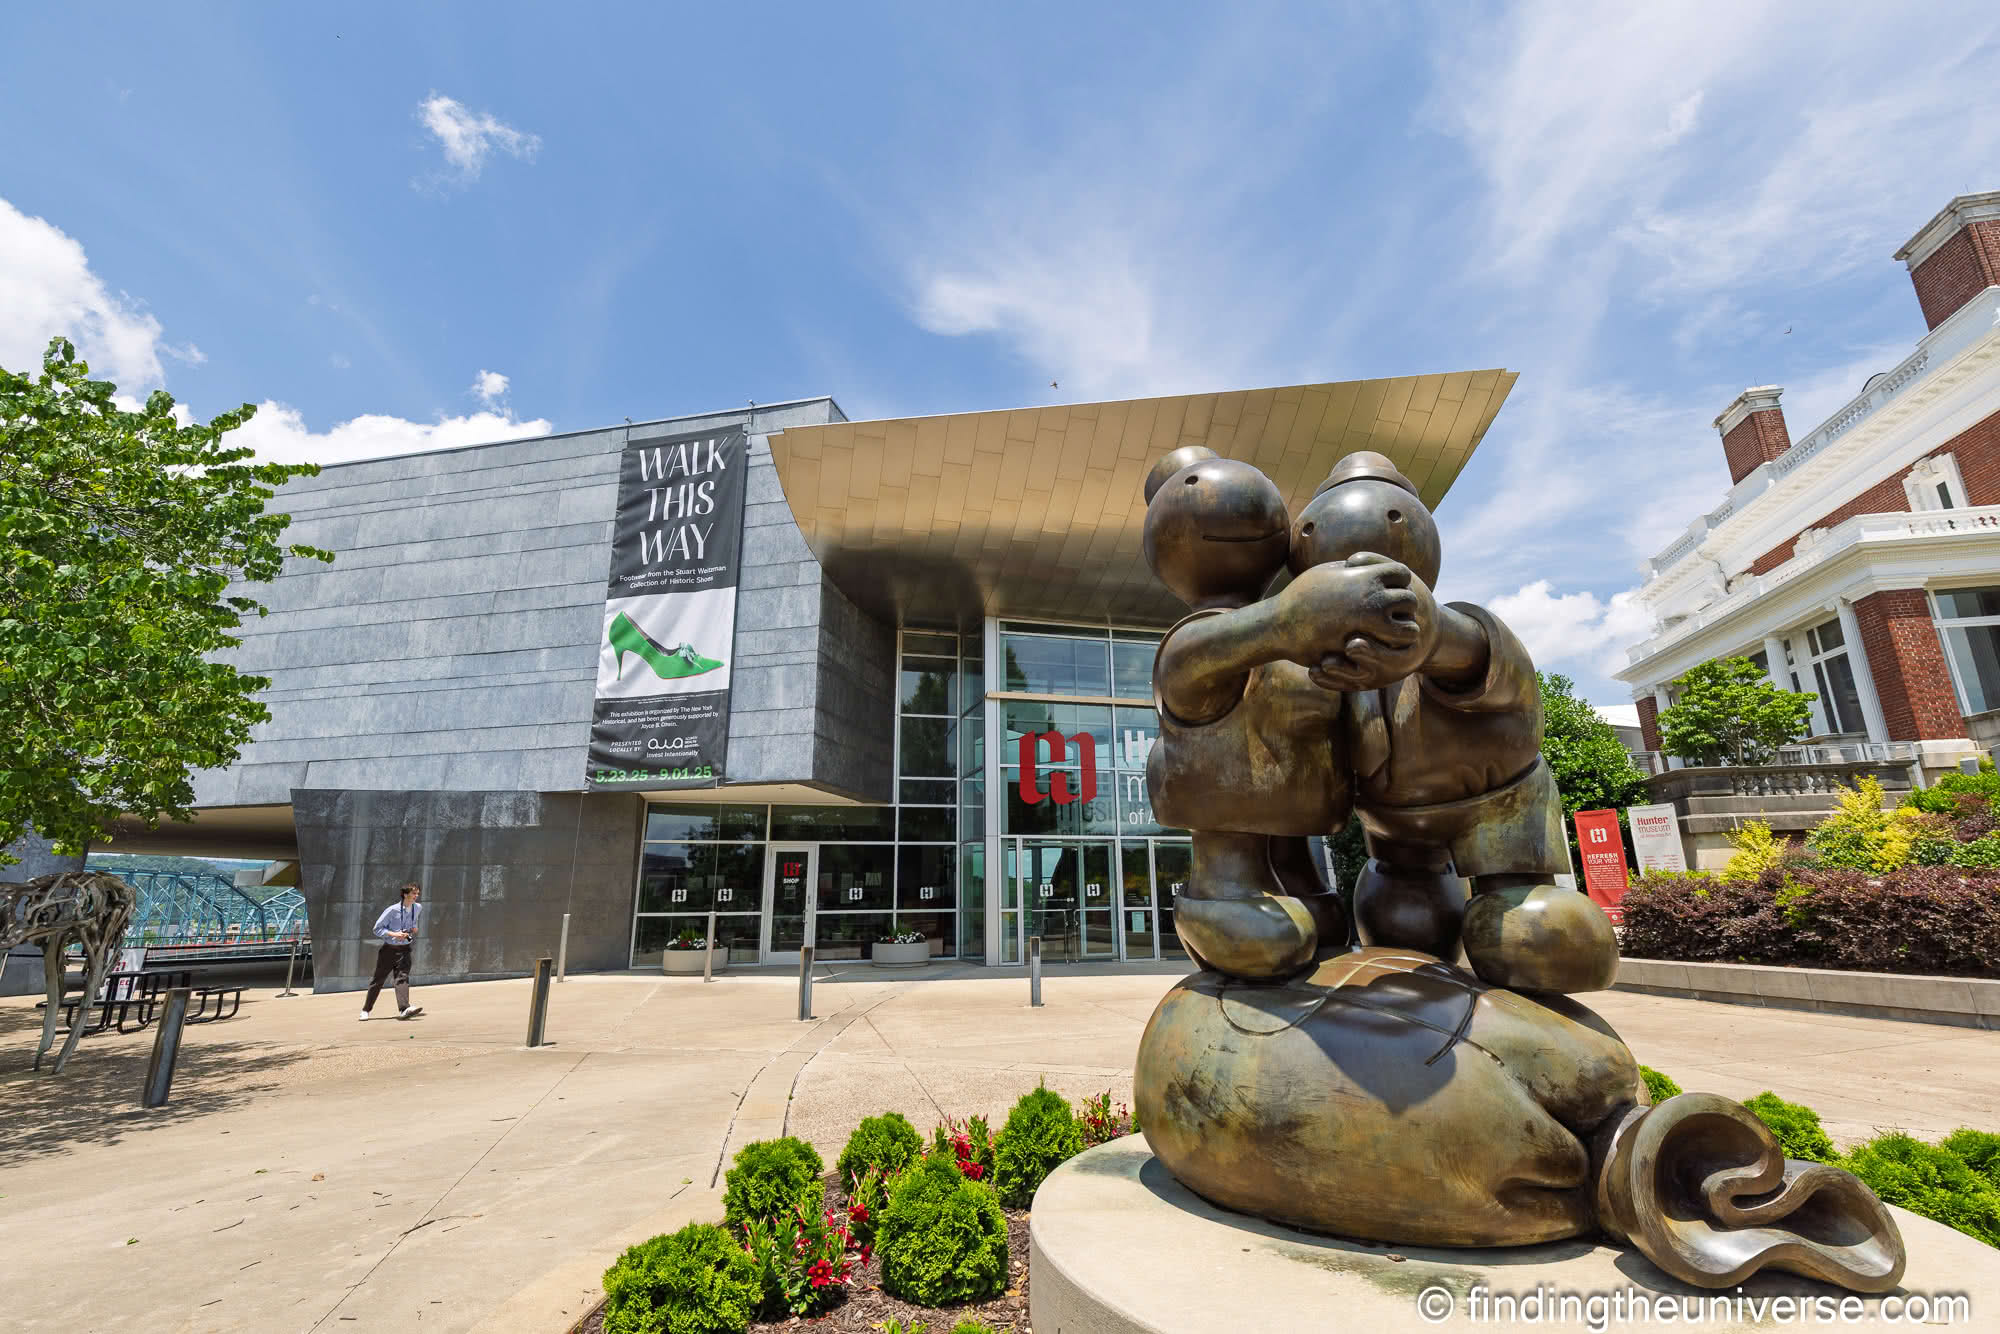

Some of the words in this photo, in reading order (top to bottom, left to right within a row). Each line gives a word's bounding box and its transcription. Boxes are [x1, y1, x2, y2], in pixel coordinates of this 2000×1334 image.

[639, 436, 728, 481] WALK
[644, 480, 715, 522] THIS
[639, 522, 714, 565] WAY
[620, 574, 646, 582] Footwear
[698, 565, 726, 574] Weitzman
[630, 580, 658, 588] Collection
[670, 576, 694, 584] Historic
[696, 576, 714, 584] Shoes
[649, 707, 673, 716] organized
[660, 714, 688, 722] generously
[688, 712, 712, 720] supported
[595, 768, 648, 783] 5.23.25
[658, 766, 712, 780] 9.01.25
[1129, 808, 1145, 824] of
[1637, 816, 1668, 826] Hunter
